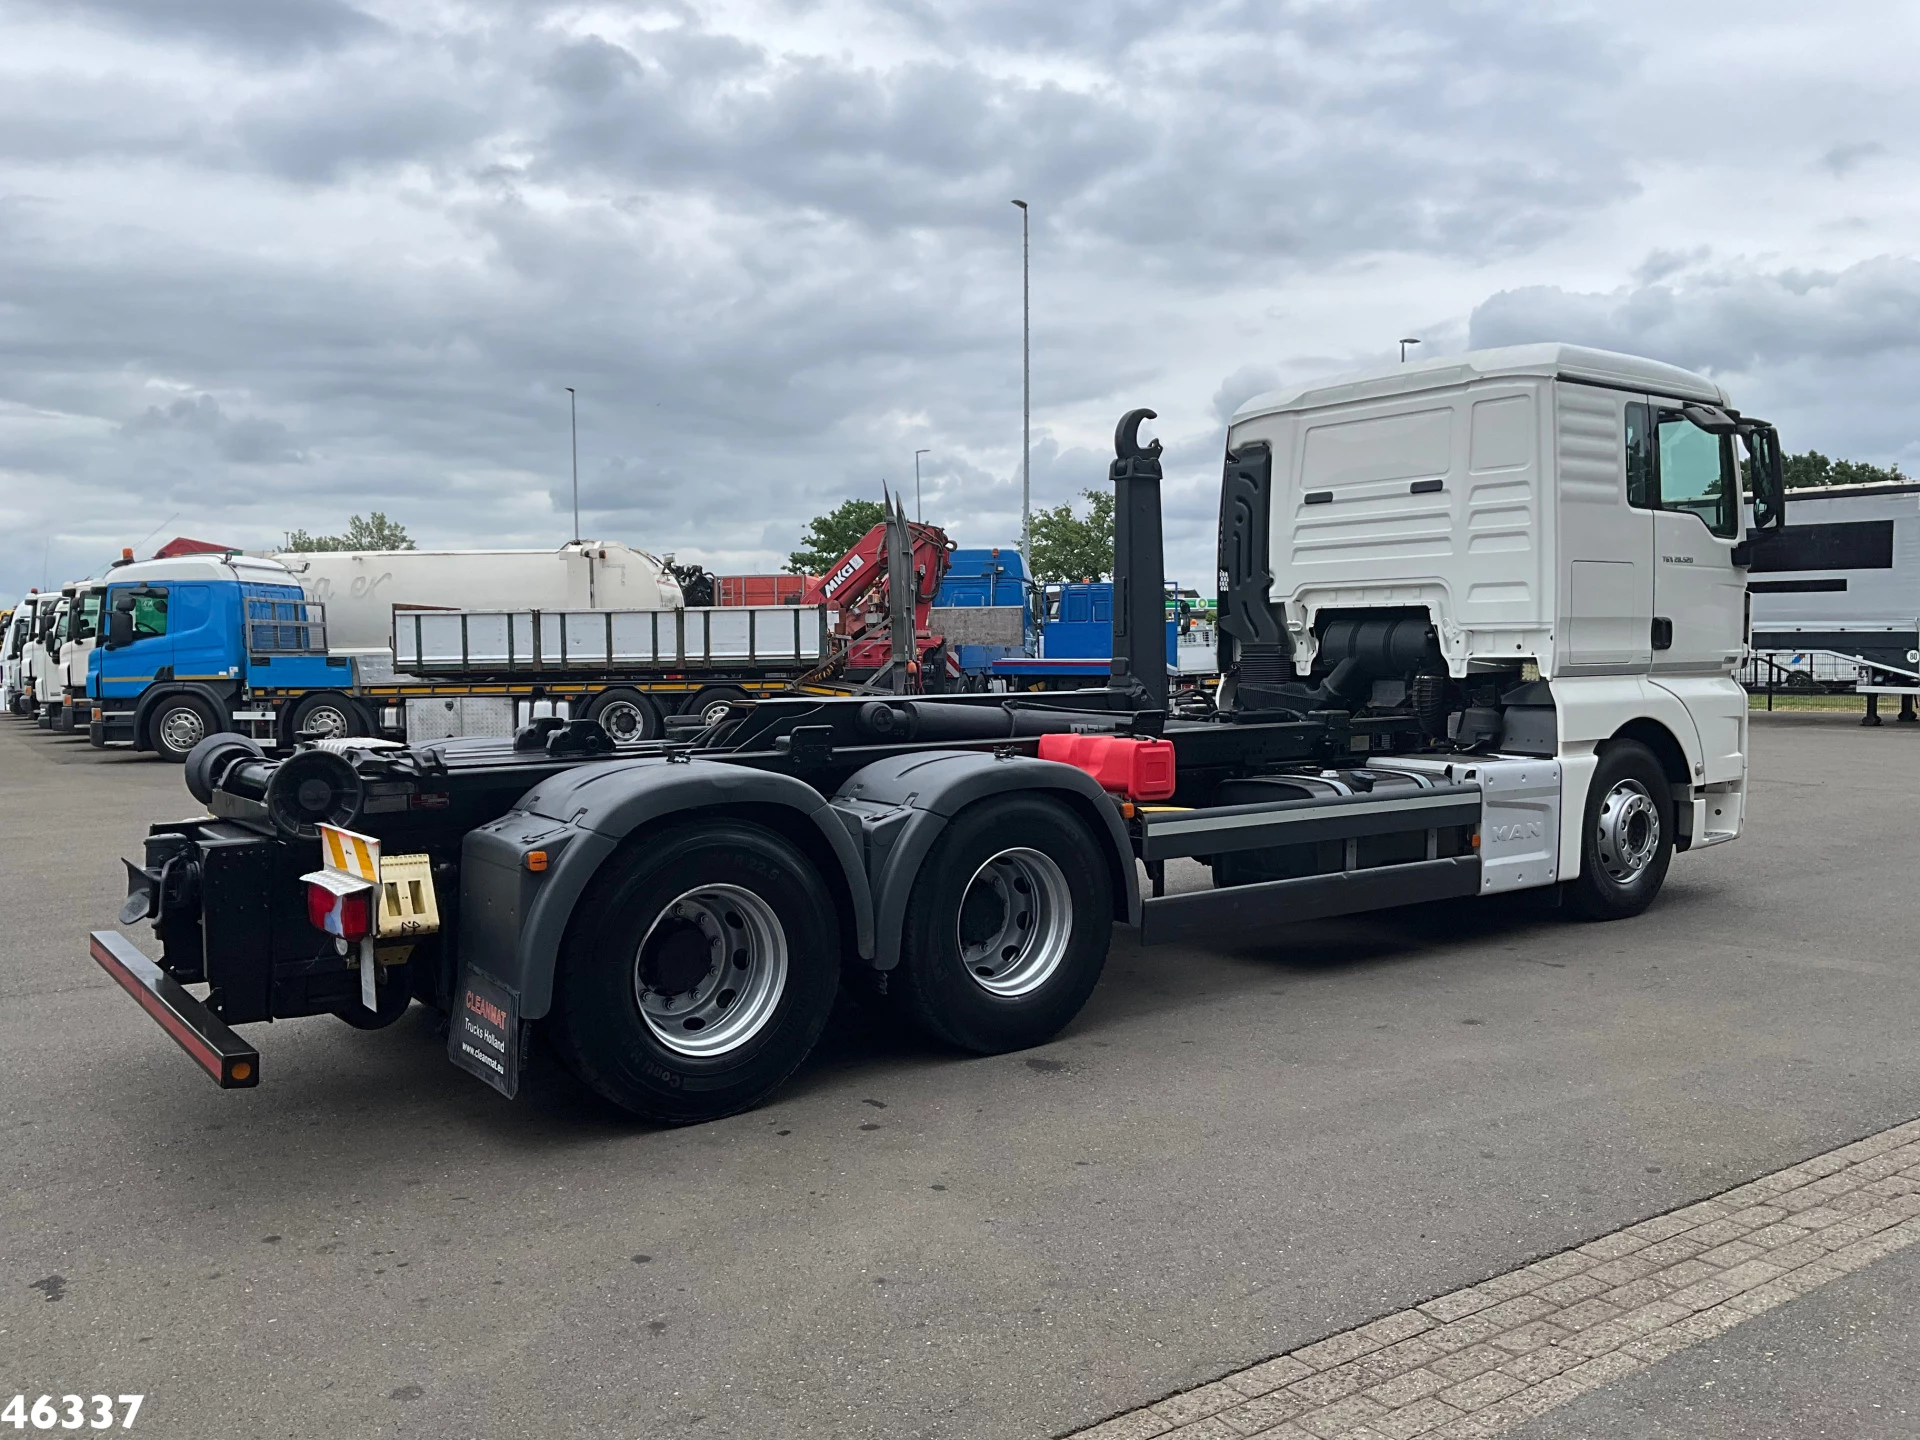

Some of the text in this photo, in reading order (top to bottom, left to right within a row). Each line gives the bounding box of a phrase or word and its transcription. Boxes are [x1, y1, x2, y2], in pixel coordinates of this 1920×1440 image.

[824, 563, 855, 599] MKG
[1909, 652, 1918, 661] 80
[1491, 821, 1542, 843] MAN
[466, 990, 507, 1030] CLEANMAT
[464, 1017, 505, 1053] Trucks Holland
[462, 1041, 504, 1075] www.cleanmat.eu
